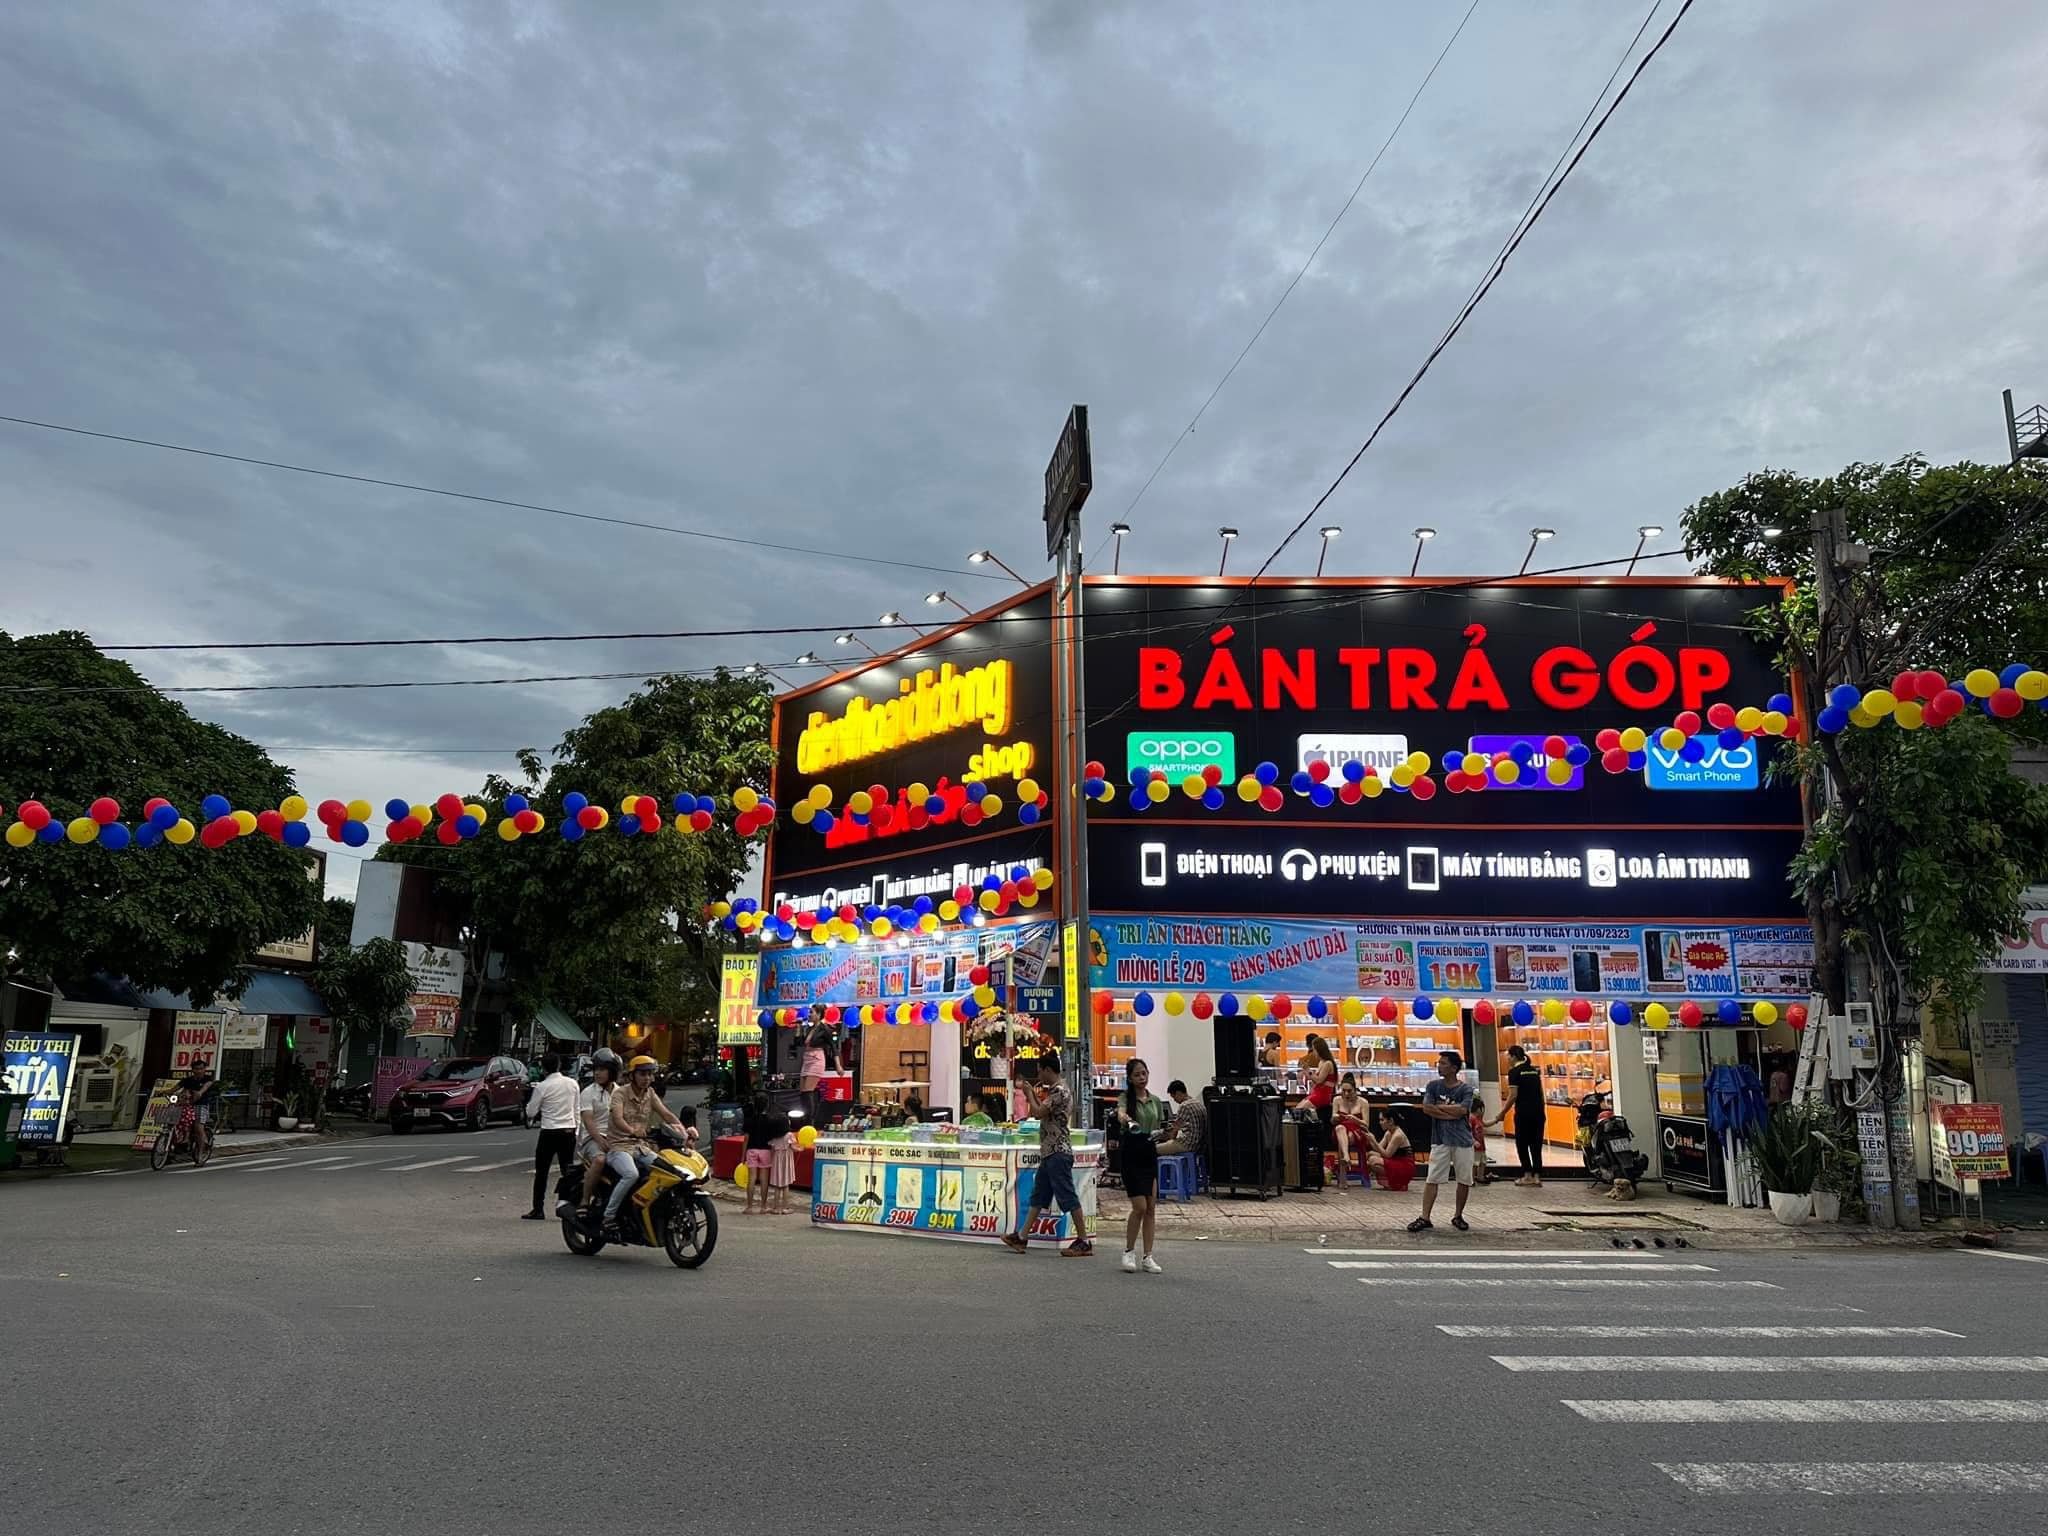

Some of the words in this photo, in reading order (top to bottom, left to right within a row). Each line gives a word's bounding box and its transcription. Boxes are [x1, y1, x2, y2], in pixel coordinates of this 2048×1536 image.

[1139, 625, 1317, 711] BÁN
[1339, 622, 1510, 711] TRẢ
[1532, 621, 1730, 711] GÓP
[1330, 750, 1404, 769] IPHONE
[1667, 770, 1700, 782] Smart
[1704, 770, 1741, 782] Phone
[1177, 849, 1218, 878] ĐIỆN
[1221, 855, 1273, 879] THOẠI
[1320, 855, 1356, 881] PHỤ
[1359, 851, 1400, 881] KIỆN
[1443, 852, 1484, 877] MÁY
[1486, 852, 1530, 877] TÍNH
[1530, 850, 1581, 878] BẢNG
[1619, 858, 1655, 878] LOA
[1656, 853, 1686, 878] ÂM
[1687, 858, 1750, 879] THANH
[1117, 923, 1141, 944] TRI
[1147, 917, 1168, 944] ÂN
[1172, 919, 1225, 945] KHÁCH
[1228, 920, 1272, 946] HÀNG
[1357, 923, 1398, 934] CHƯƠNG
[1400, 923, 1431, 935] TRÌNH
[1434, 923, 1460, 936] GIẢM
[1544, 926, 1570, 938] NGÀY
[1574, 928, 1630, 939] 01/09/2323
[1685, 931, 1704, 940] OPPO
[1230, 957, 1265, 982] HÀNG
[1267, 943, 1301, 972] NGÀN
[1305, 937, 1322, 961] ƯU
[1324, 928, 1348, 956] ĐÃI
[2003, 960, 2020, 968] CARD
[2021, 960, 2036, 968] VISIT
[1117, 953, 1159, 983] MỪNG
[1163, 950, 1180, 983] LỄ
[1183, 960, 1205, 983] 2/9
[1384, 970, 1414, 987] 39%
[1429, 963, 1482, 990] 19K
[1687, 975, 1732, 992] 6.290.000đ
[177, 1025, 217, 1044] NHÀ
[5, 1036, 41, 1053] SIÊU
[44, 1040, 72, 1056] THỊ
[828, 1146, 845, 1155] NGHE
[815, 1203, 840, 1220] 39K
[847, 1206, 878, 1222] 29K
[887, 1208, 917, 1225] 39K
[928, 1212, 956, 1229] 99K
[970, 1215, 999, 1232] 39K
